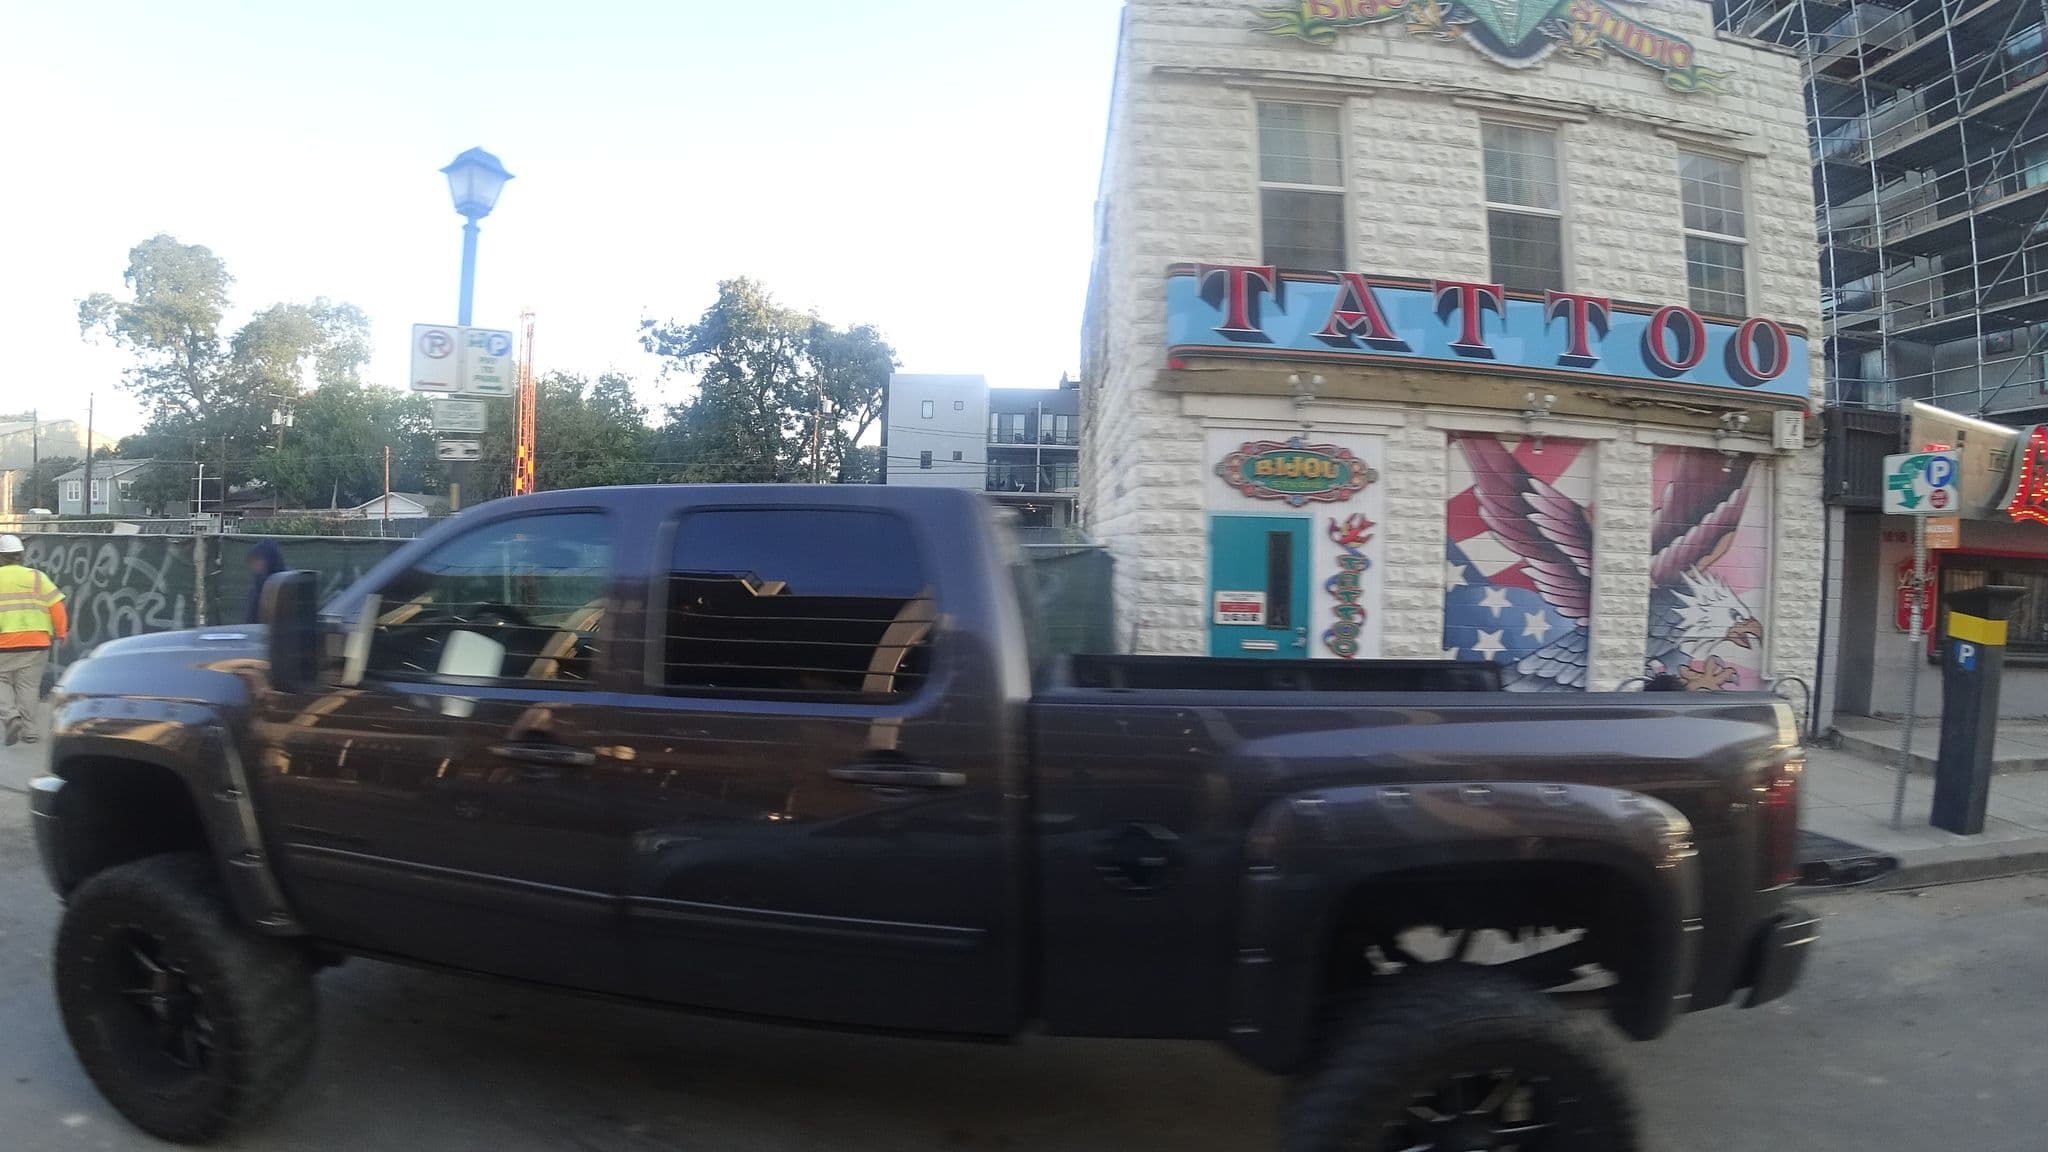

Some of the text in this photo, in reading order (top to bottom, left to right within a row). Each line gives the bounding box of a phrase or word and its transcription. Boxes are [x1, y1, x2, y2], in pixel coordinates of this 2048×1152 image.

[1194, 263, 1791, 383] TATTOO
[1255, 457, 1338, 478] BIJOU
[1931, 460, 1950, 485] P
[1958, 644, 1974, 663] P
